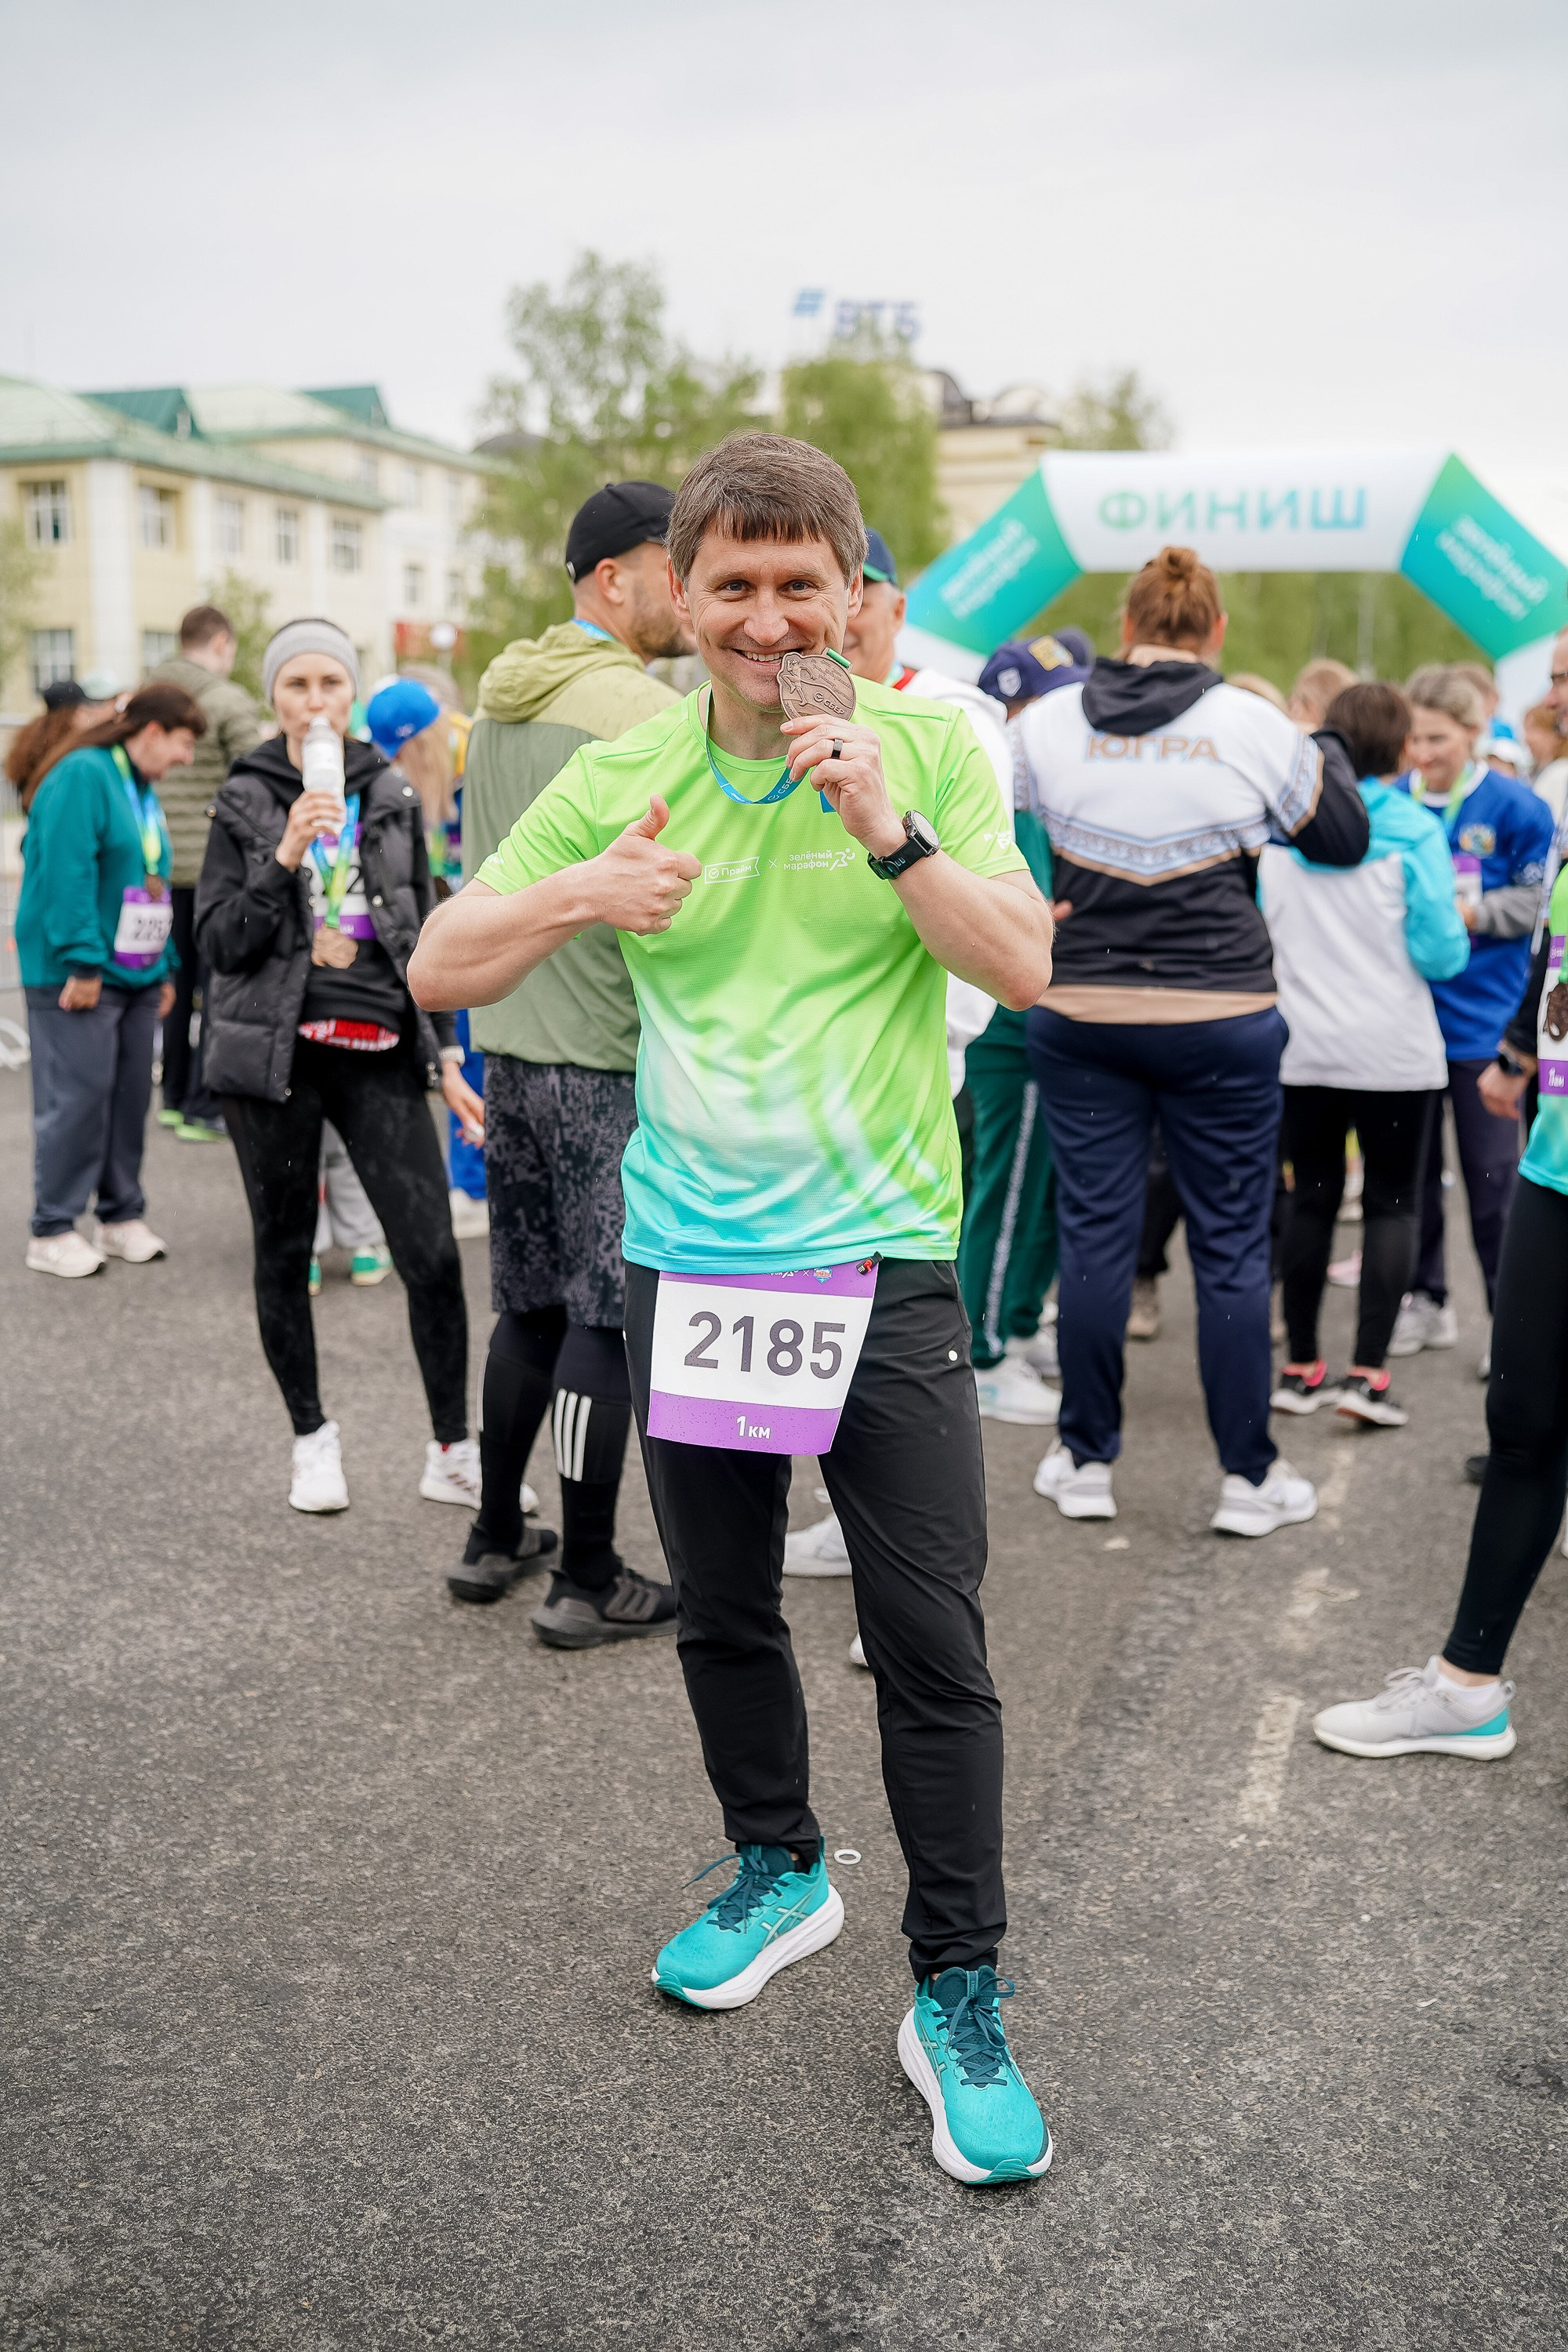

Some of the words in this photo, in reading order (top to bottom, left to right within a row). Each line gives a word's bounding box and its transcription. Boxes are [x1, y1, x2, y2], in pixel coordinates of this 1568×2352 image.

[1099, 489, 1366, 532] ФИНИШ
[823, 700, 845, 715] СБЕР
[1087, 733, 1221, 762] ЮГРА
[789, 849, 833, 862] зелёный
[720, 864, 752, 877] Прайм
[784, 858, 829, 872] марафон
[684, 1311, 846, 1380] 2185
